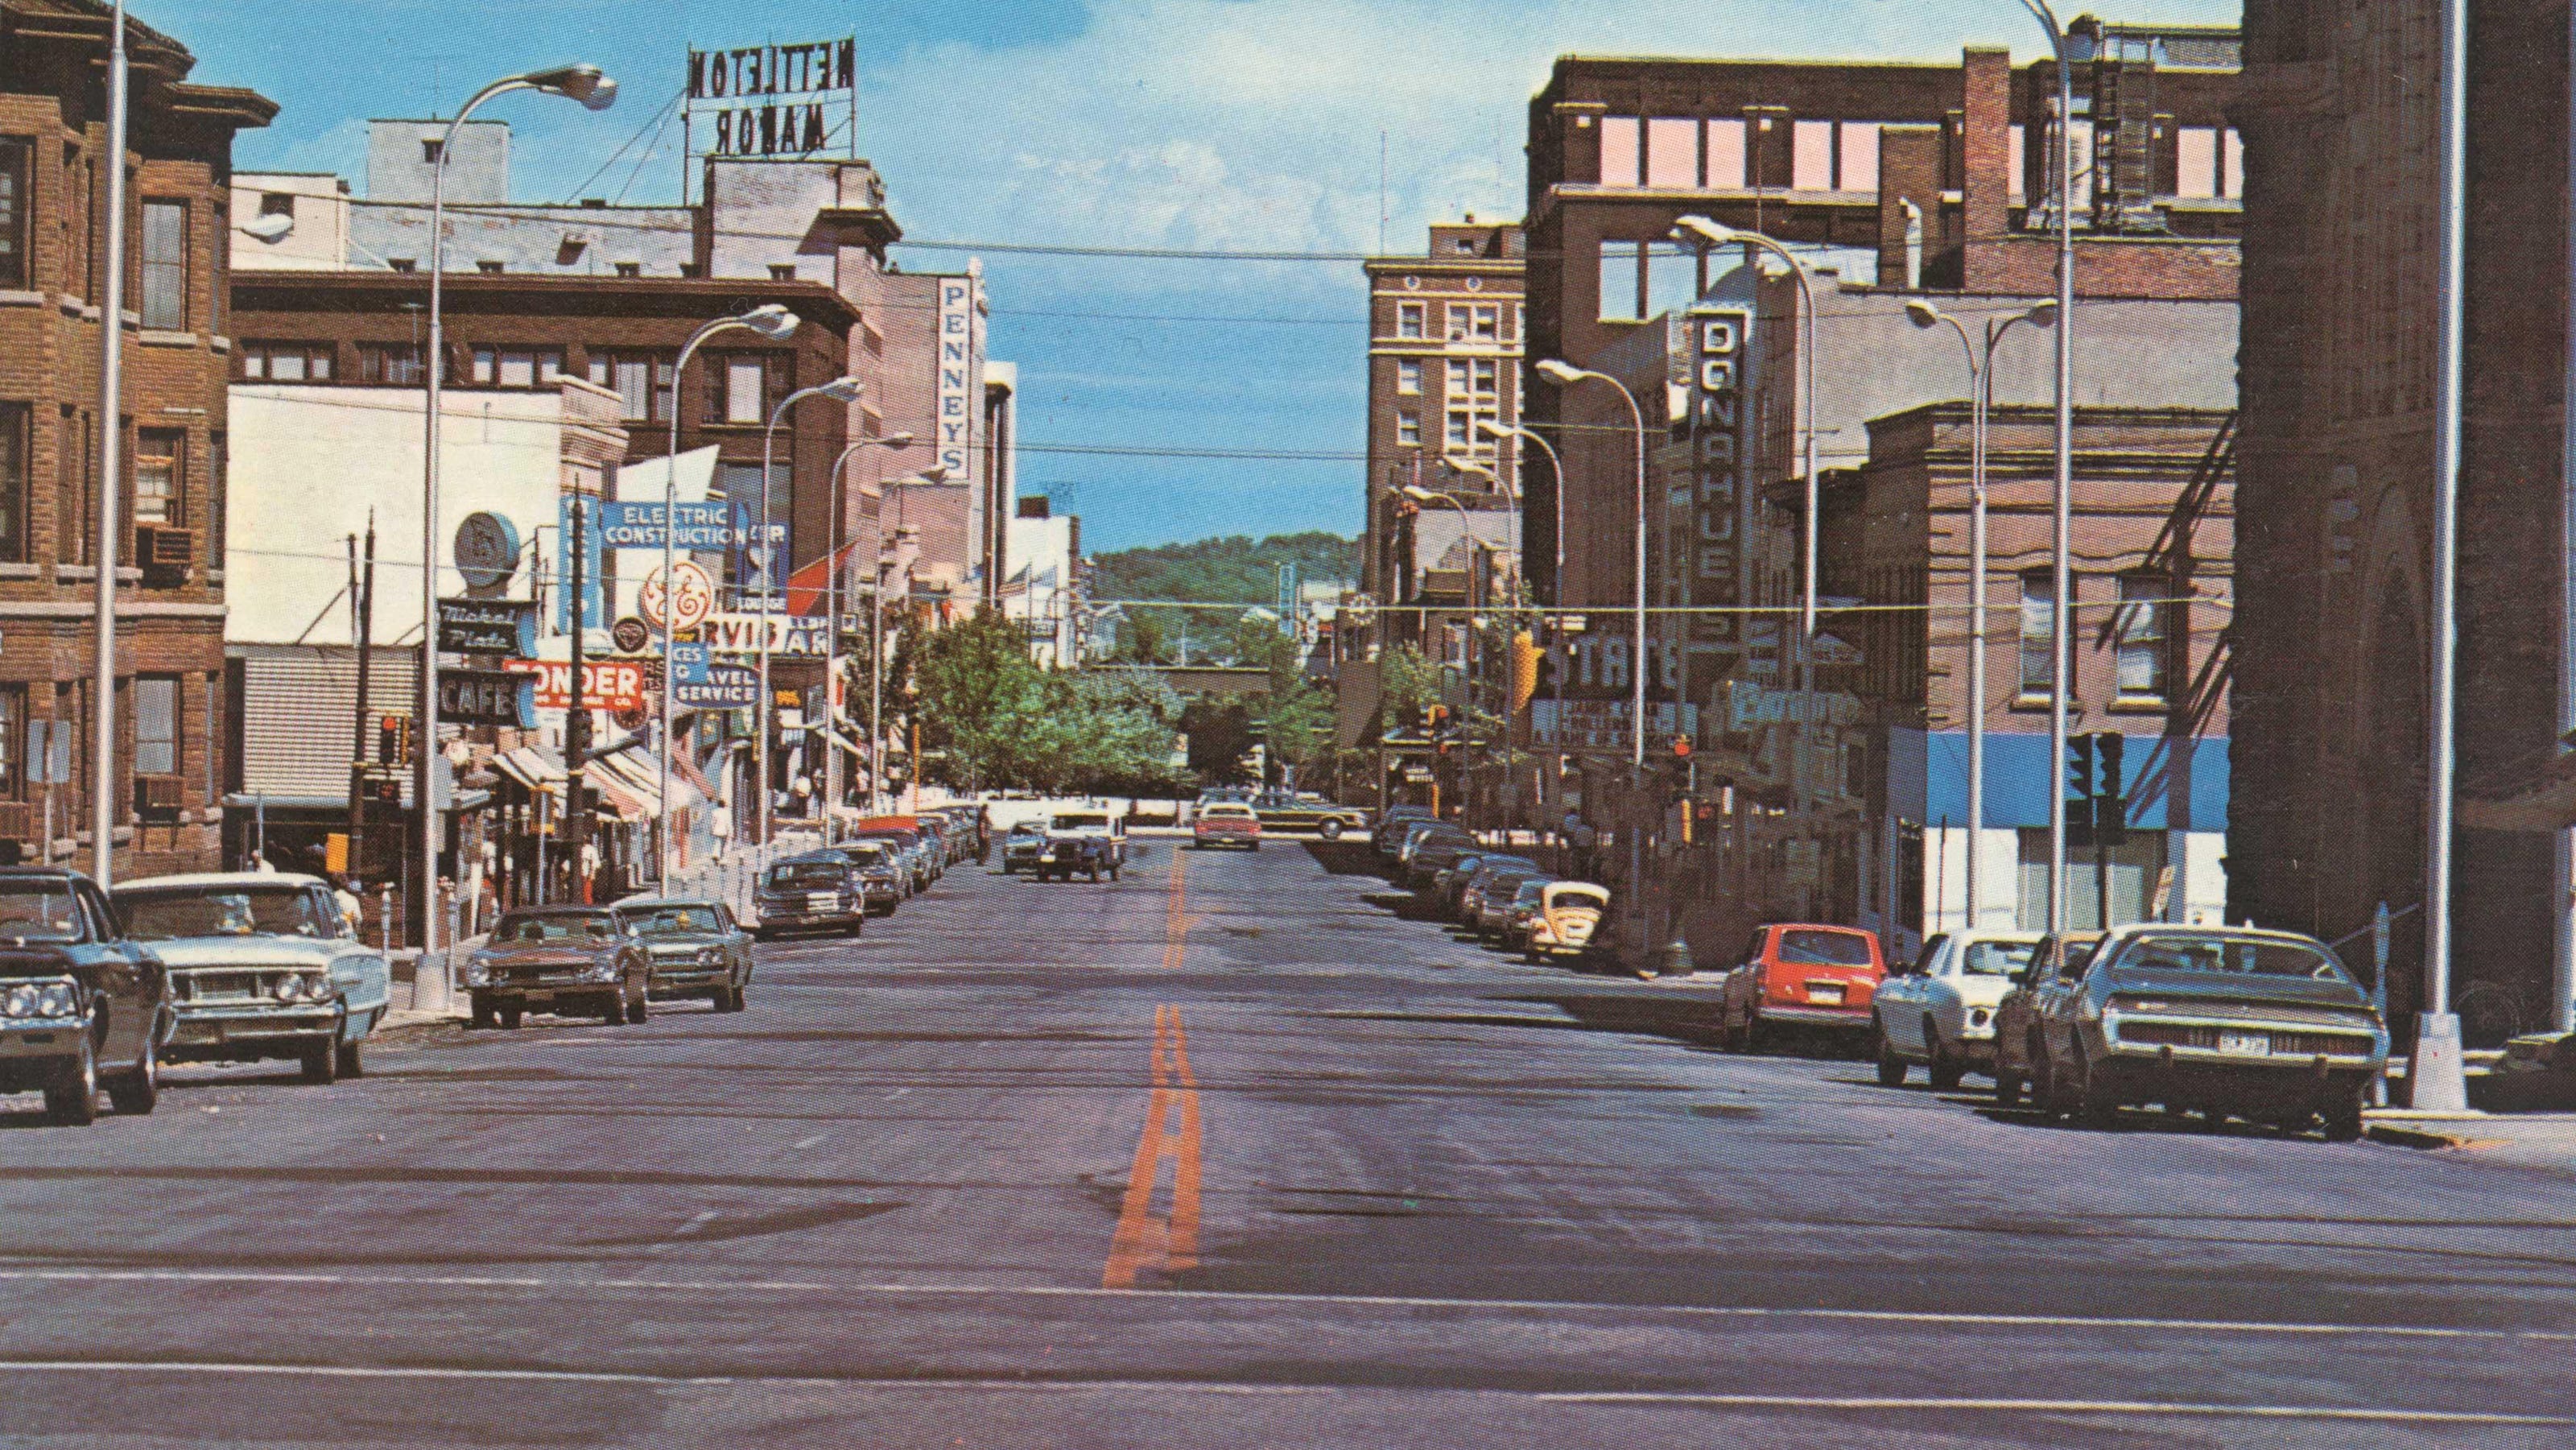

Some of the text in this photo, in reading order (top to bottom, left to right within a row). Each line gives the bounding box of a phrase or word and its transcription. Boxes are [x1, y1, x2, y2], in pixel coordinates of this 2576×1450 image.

[943, 286, 964, 471] PENNEYS
[736, 597, 787, 611] LOUGE
[440, 605, 517, 625] Nickel
[448, 628, 510, 649] Plate
[509, 664, 638, 697] ONDER
[440, 678, 512, 716] CAFE
[676, 685, 757, 701] SERVICE
